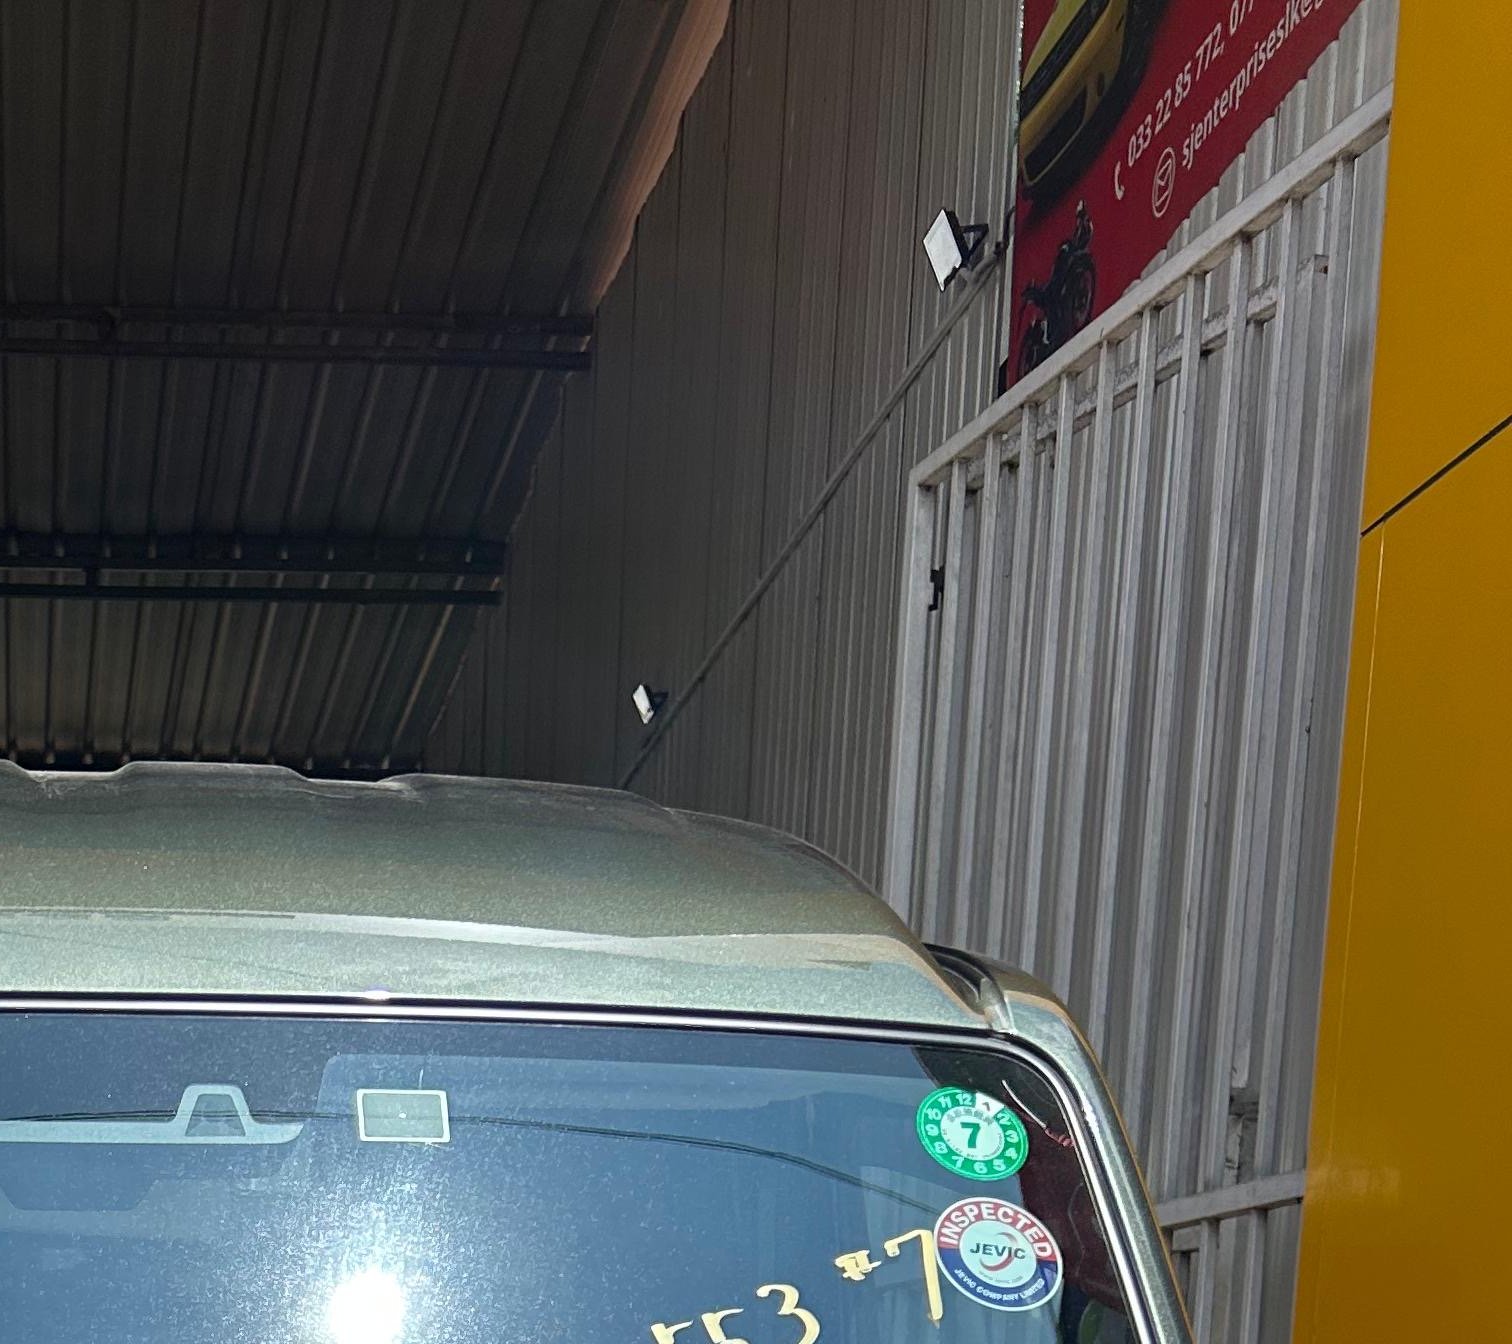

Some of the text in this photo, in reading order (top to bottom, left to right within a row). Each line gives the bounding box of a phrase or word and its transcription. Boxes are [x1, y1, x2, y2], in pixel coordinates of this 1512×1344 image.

[1128, 114, 1152, 167] 033
[1154, 88, 1172, 135] 22
[1174, 62, 1191, 108] 85
[955, 1092, 973, 1106] 12
[925, 1107, 942, 1121] 10
[996, 1112, 1012, 1125] 2
[925, 1123, 939, 1136] 9
[959, 1121, 981, 1149] 7
[1005, 1130, 1019, 1143] 3
[933, 1141, 948, 1154] 8
[951, 1155, 965, 1168] 7
[973, 1161, 988, 1174] 6
[992, 1159, 1006, 1172] 5
[939, 1202, 1053, 1258] INSPECTED
[969, 1242, 1026, 1260] JEVIC
